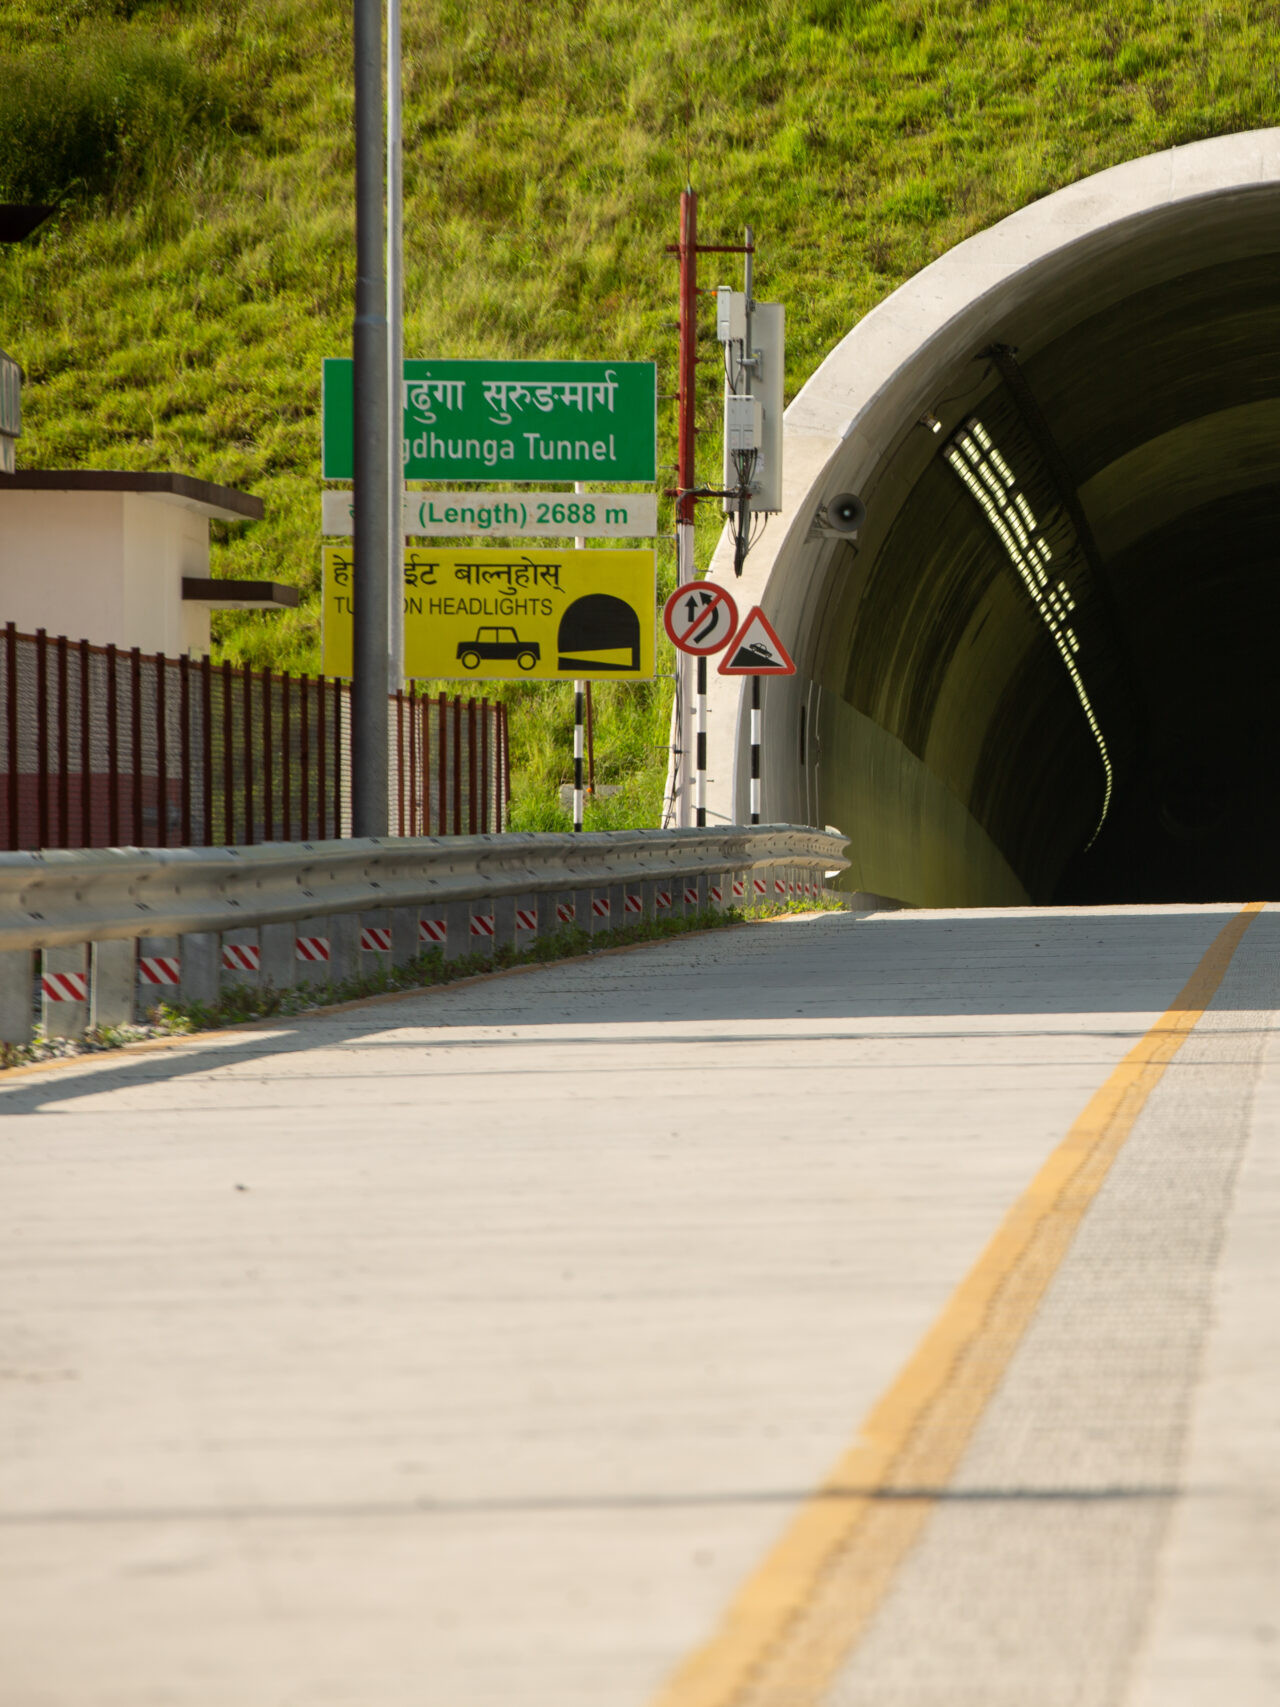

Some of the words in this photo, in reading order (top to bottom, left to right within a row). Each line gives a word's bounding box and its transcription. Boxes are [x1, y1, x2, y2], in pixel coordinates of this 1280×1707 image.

[402, 371, 466, 424] ढुंगा
[402, 431, 515, 466] gdhunga
[523, 432, 617, 461] Tunnel
[418, 502, 527, 529] (Length)
[536, 502, 596, 524] 2688
[604, 508, 628, 524] m
[454, 556, 566, 595] बाल्नुहोस्
[333, 596, 355, 616] TU
[429, 597, 553, 616] HEADLIGHTS
